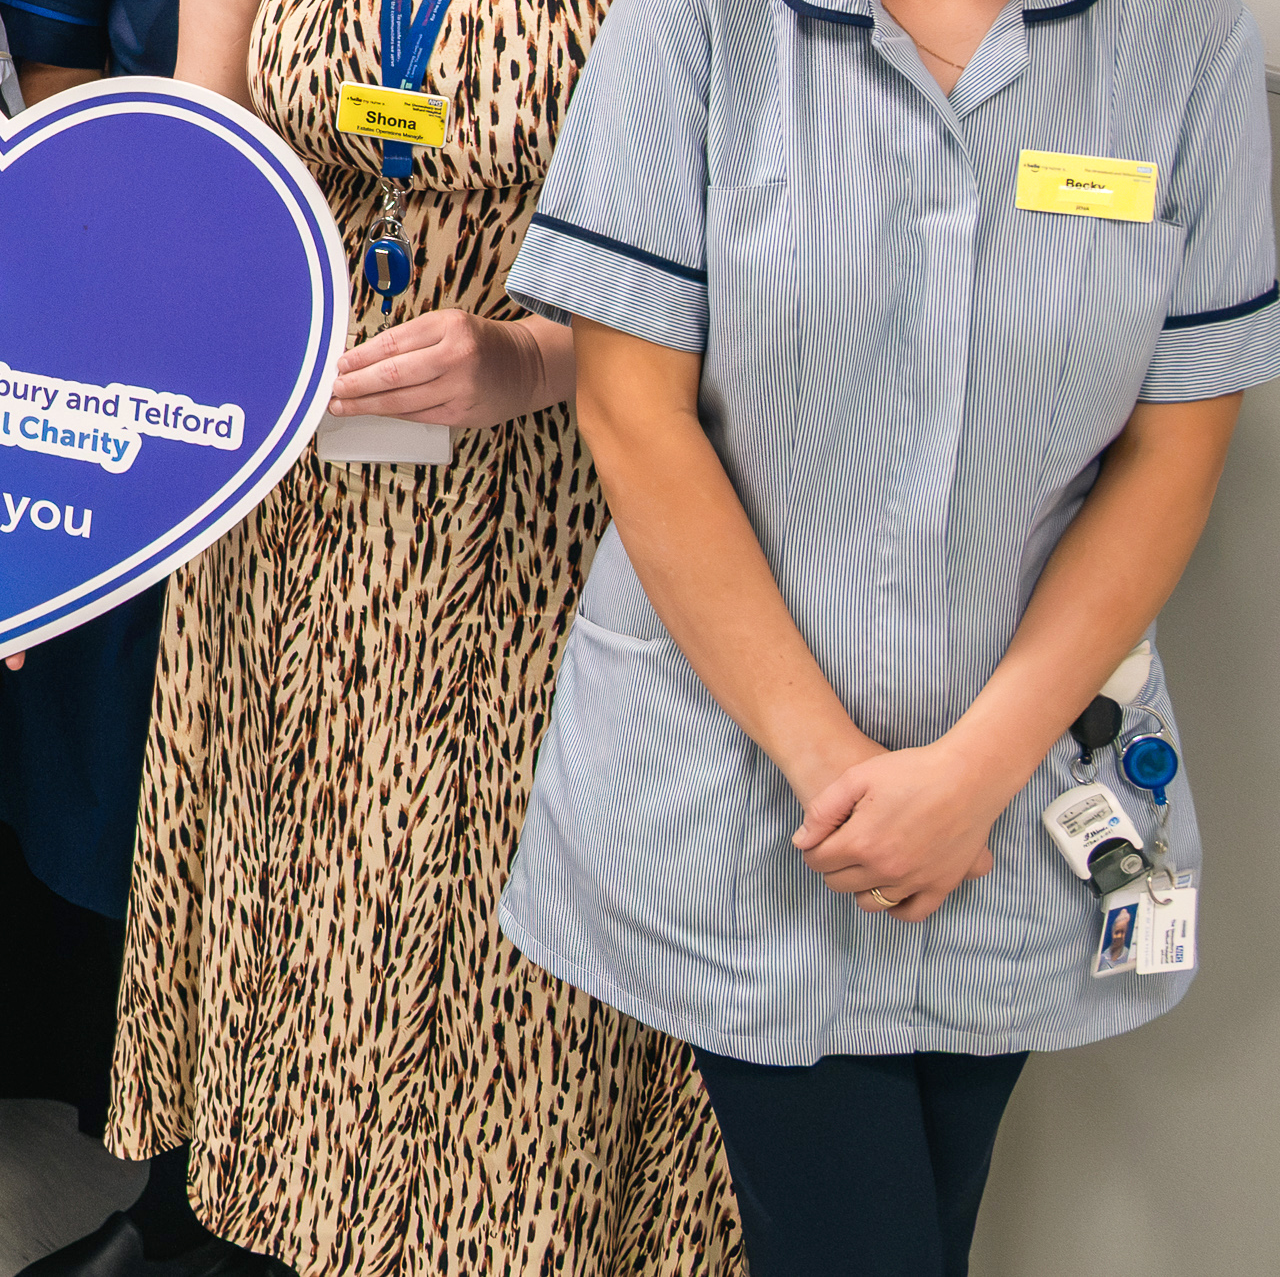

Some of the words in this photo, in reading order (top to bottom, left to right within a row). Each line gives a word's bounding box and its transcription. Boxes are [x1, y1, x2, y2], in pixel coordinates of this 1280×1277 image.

[366, 111, 416, 130] Shona
[19, 416, 131, 463] Charity
[66, 395, 120, 417] and
[129, 397, 233, 439] Telford
[0, 491, 94, 539] you
